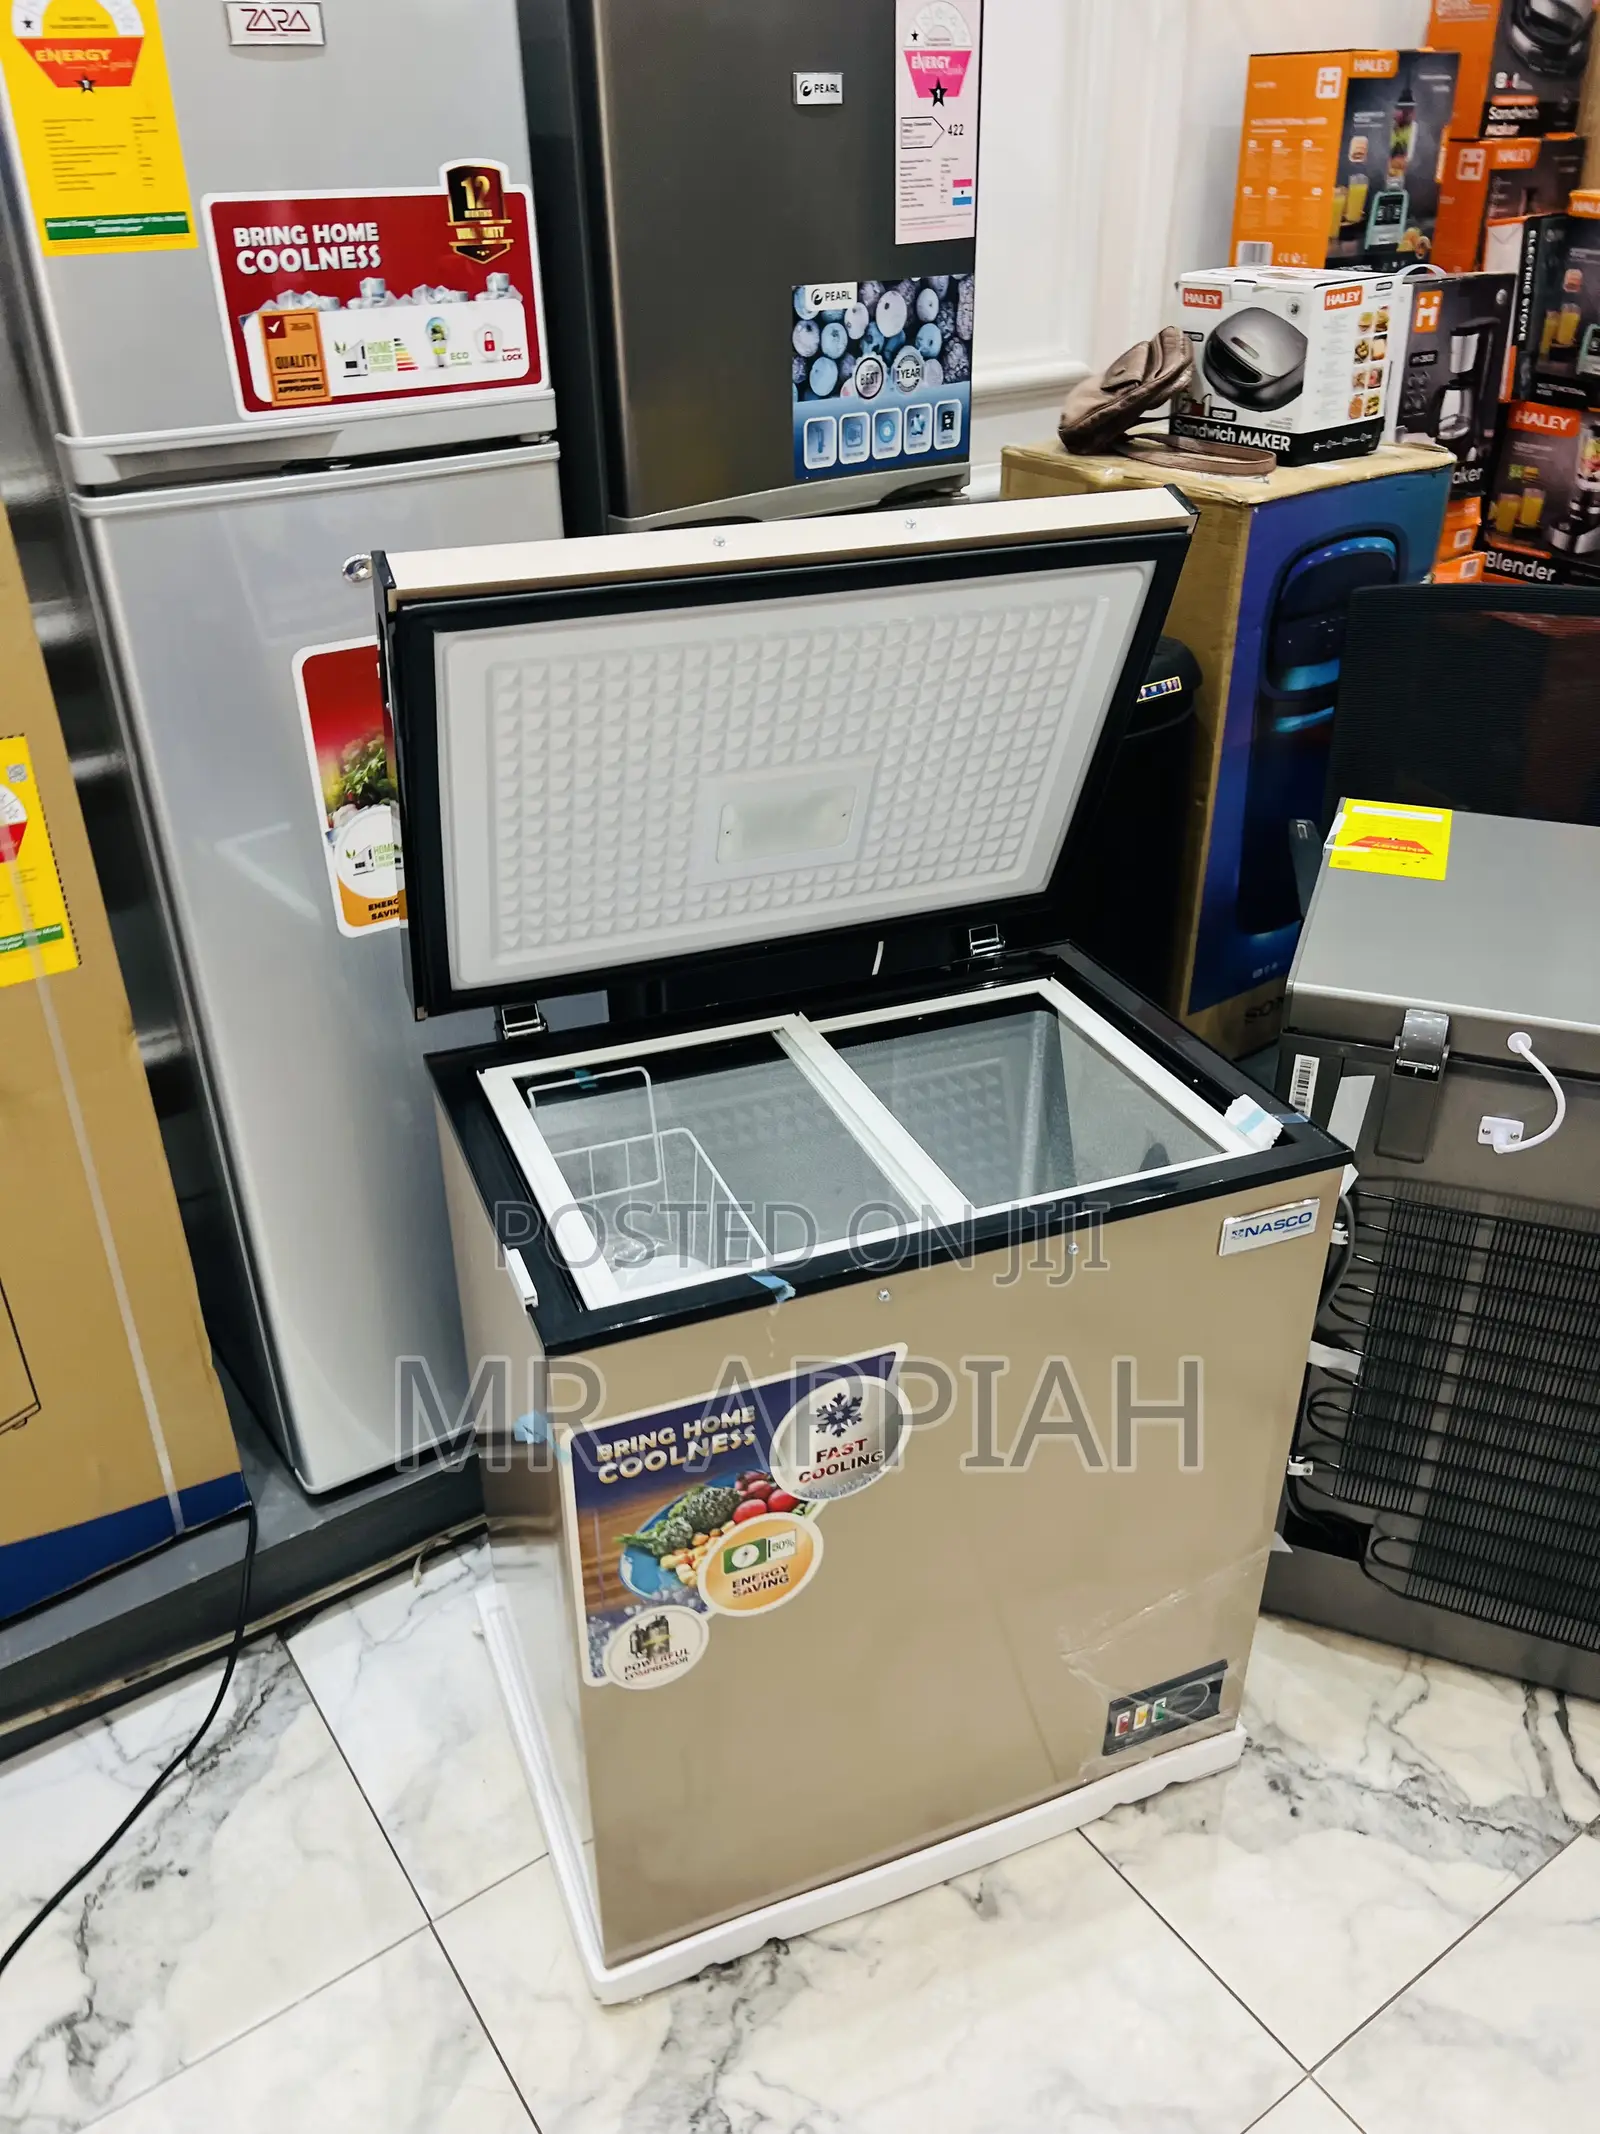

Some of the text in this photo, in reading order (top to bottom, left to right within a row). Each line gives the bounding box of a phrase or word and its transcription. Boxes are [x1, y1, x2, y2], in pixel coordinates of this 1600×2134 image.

[240, 9, 311, 32] ZARA
[35, 48, 112, 64] ENERGY
[911, 54, 951, 70] ENERGY
[1354, 58, 1393, 72] HALEY
[814, 83, 840, 93] PEARL
[948, 123, 965, 136] 422
[461, 175, 491, 210] 12
[233, 222, 380, 248] BRING HOME
[236, 244, 381, 275] COOLNESS
[824, 291, 853, 302] PEARL
[1517, 229, 1537, 341] ELECTRIC STOVE
[1184, 291, 1220, 305] HALEY
[1326, 289, 1361, 306] HALEY
[275, 354, 318, 370] QUALITY
[450, 351, 469, 360] ECO
[502, 353, 523, 361] LOCK
[860, 371, 880, 386] BEST
[901, 368, 921, 379] YEAR
[1515, 410, 1572, 432] HALEY
[1174, 419, 1291, 452] Sandwich MAKER
[1451, 467, 1485, 485] aker
[1485, 550, 1557, 582] Blender
[1244, 1212, 1313, 1238] NASCO
[596, 1405, 756, 1462] BRING HOME
[597, 1425, 757, 1485] COOLNESS
[816, 1438, 868, 1464] FAST
[798, 1450, 885, 1484] COOLING
[732, 1564, 789, 1589] ENERGY
[732, 1574, 790, 1598] SAVING
[624, 1648, 690, 1674] POWERFUL
[624, 1656, 689, 1681] COMPRESSOR
